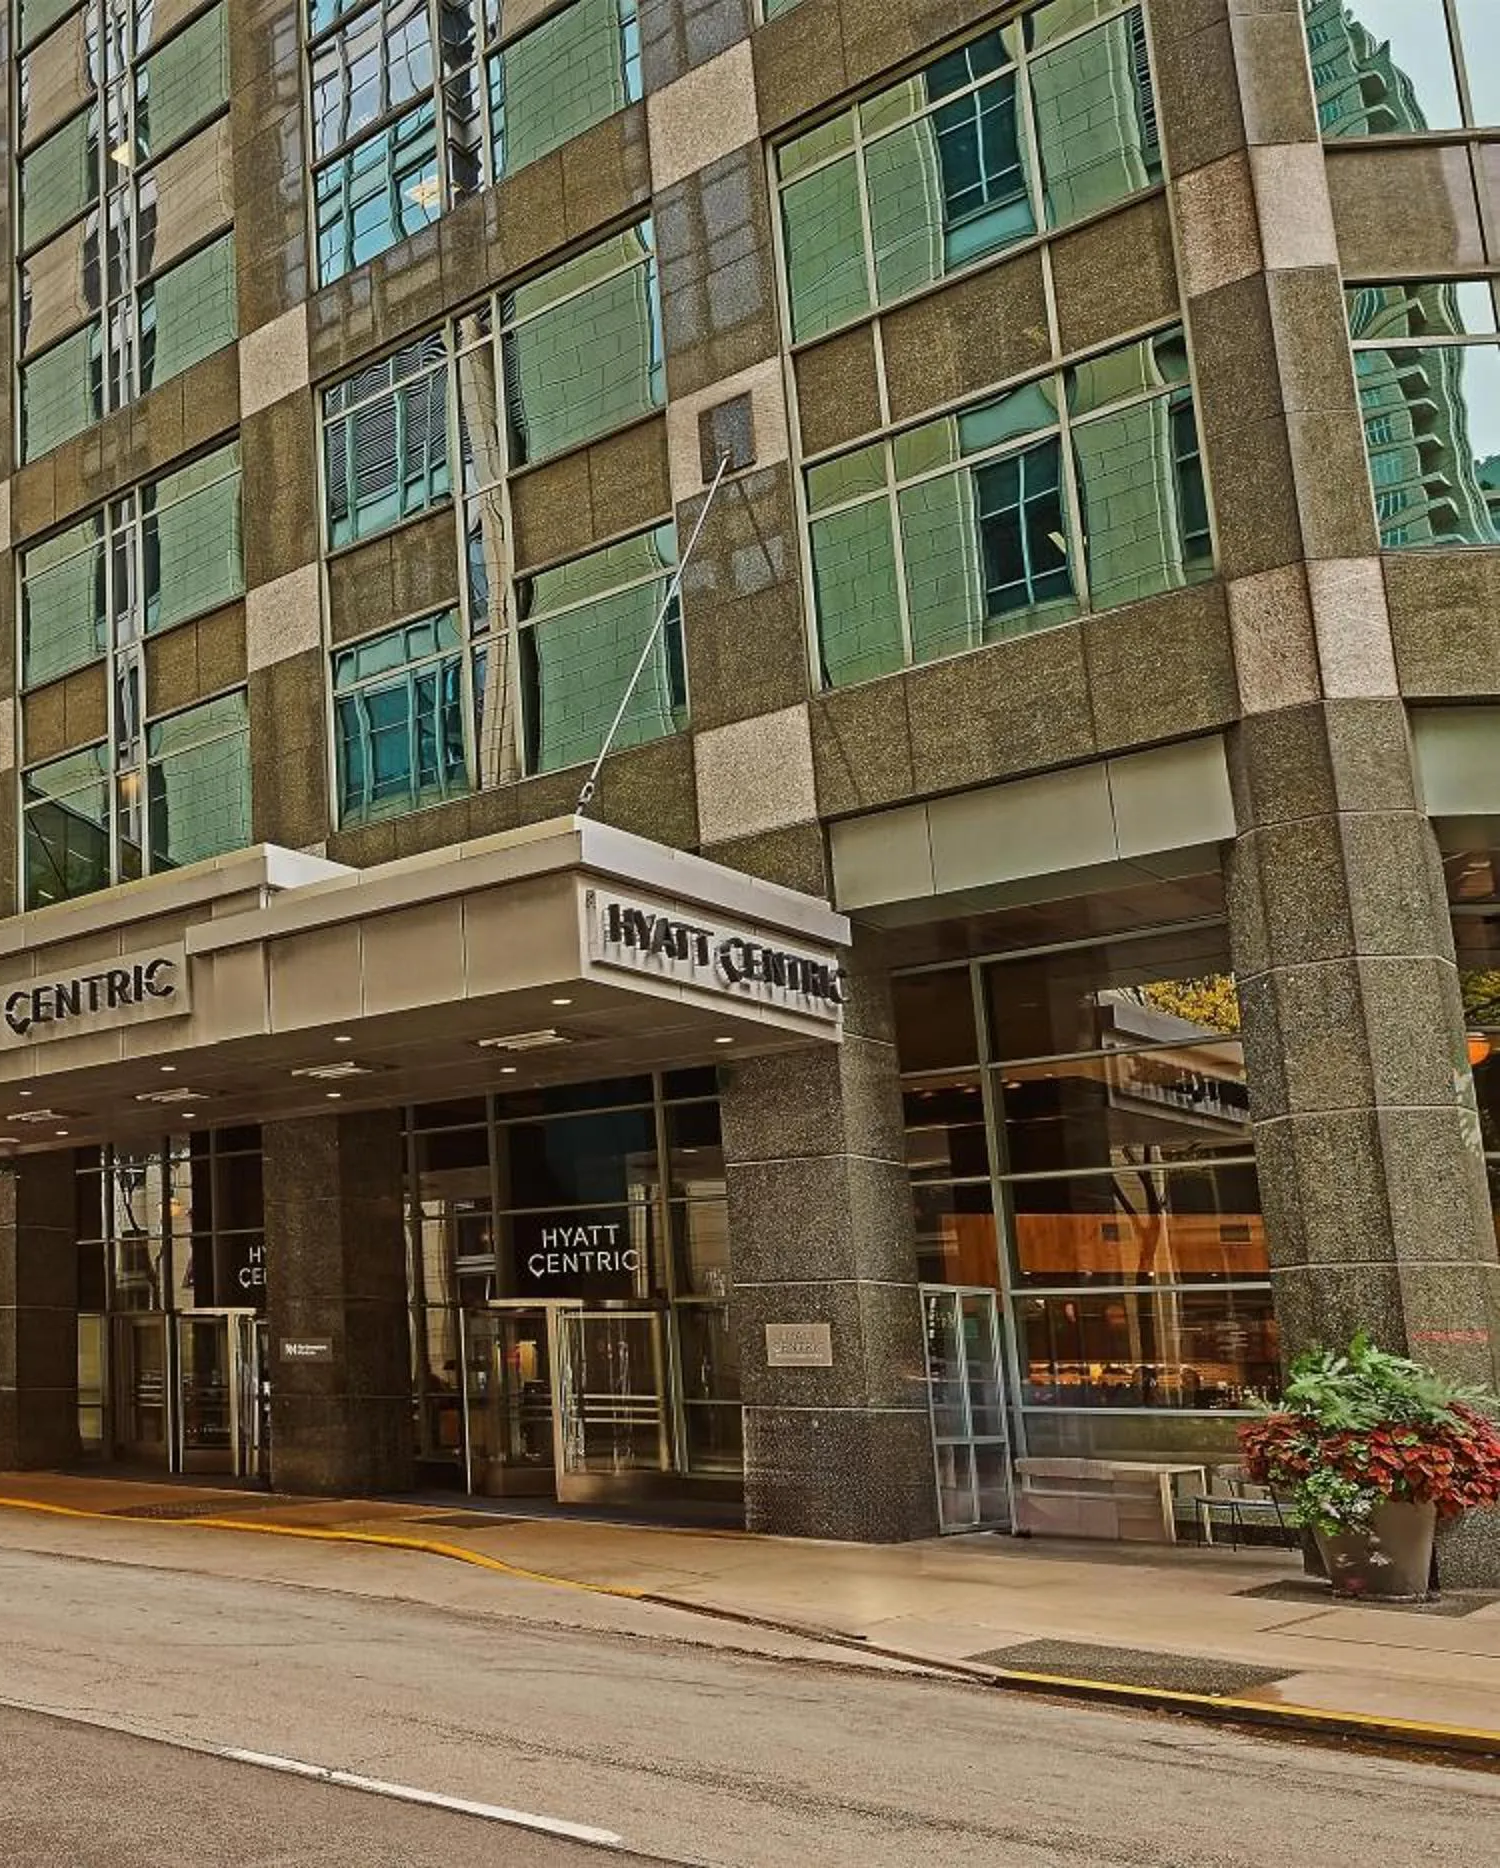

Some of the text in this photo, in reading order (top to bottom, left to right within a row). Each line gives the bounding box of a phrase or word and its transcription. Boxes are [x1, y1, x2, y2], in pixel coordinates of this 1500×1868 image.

[604, 903, 848, 1004] HYATT CENTRIC
[5, 958, 176, 1035] CENTRIC
[541, 1224, 620, 1249] HYATT
[239, 1267, 267, 1288] CE
[528, 1249, 641, 1278] CENTRIC
